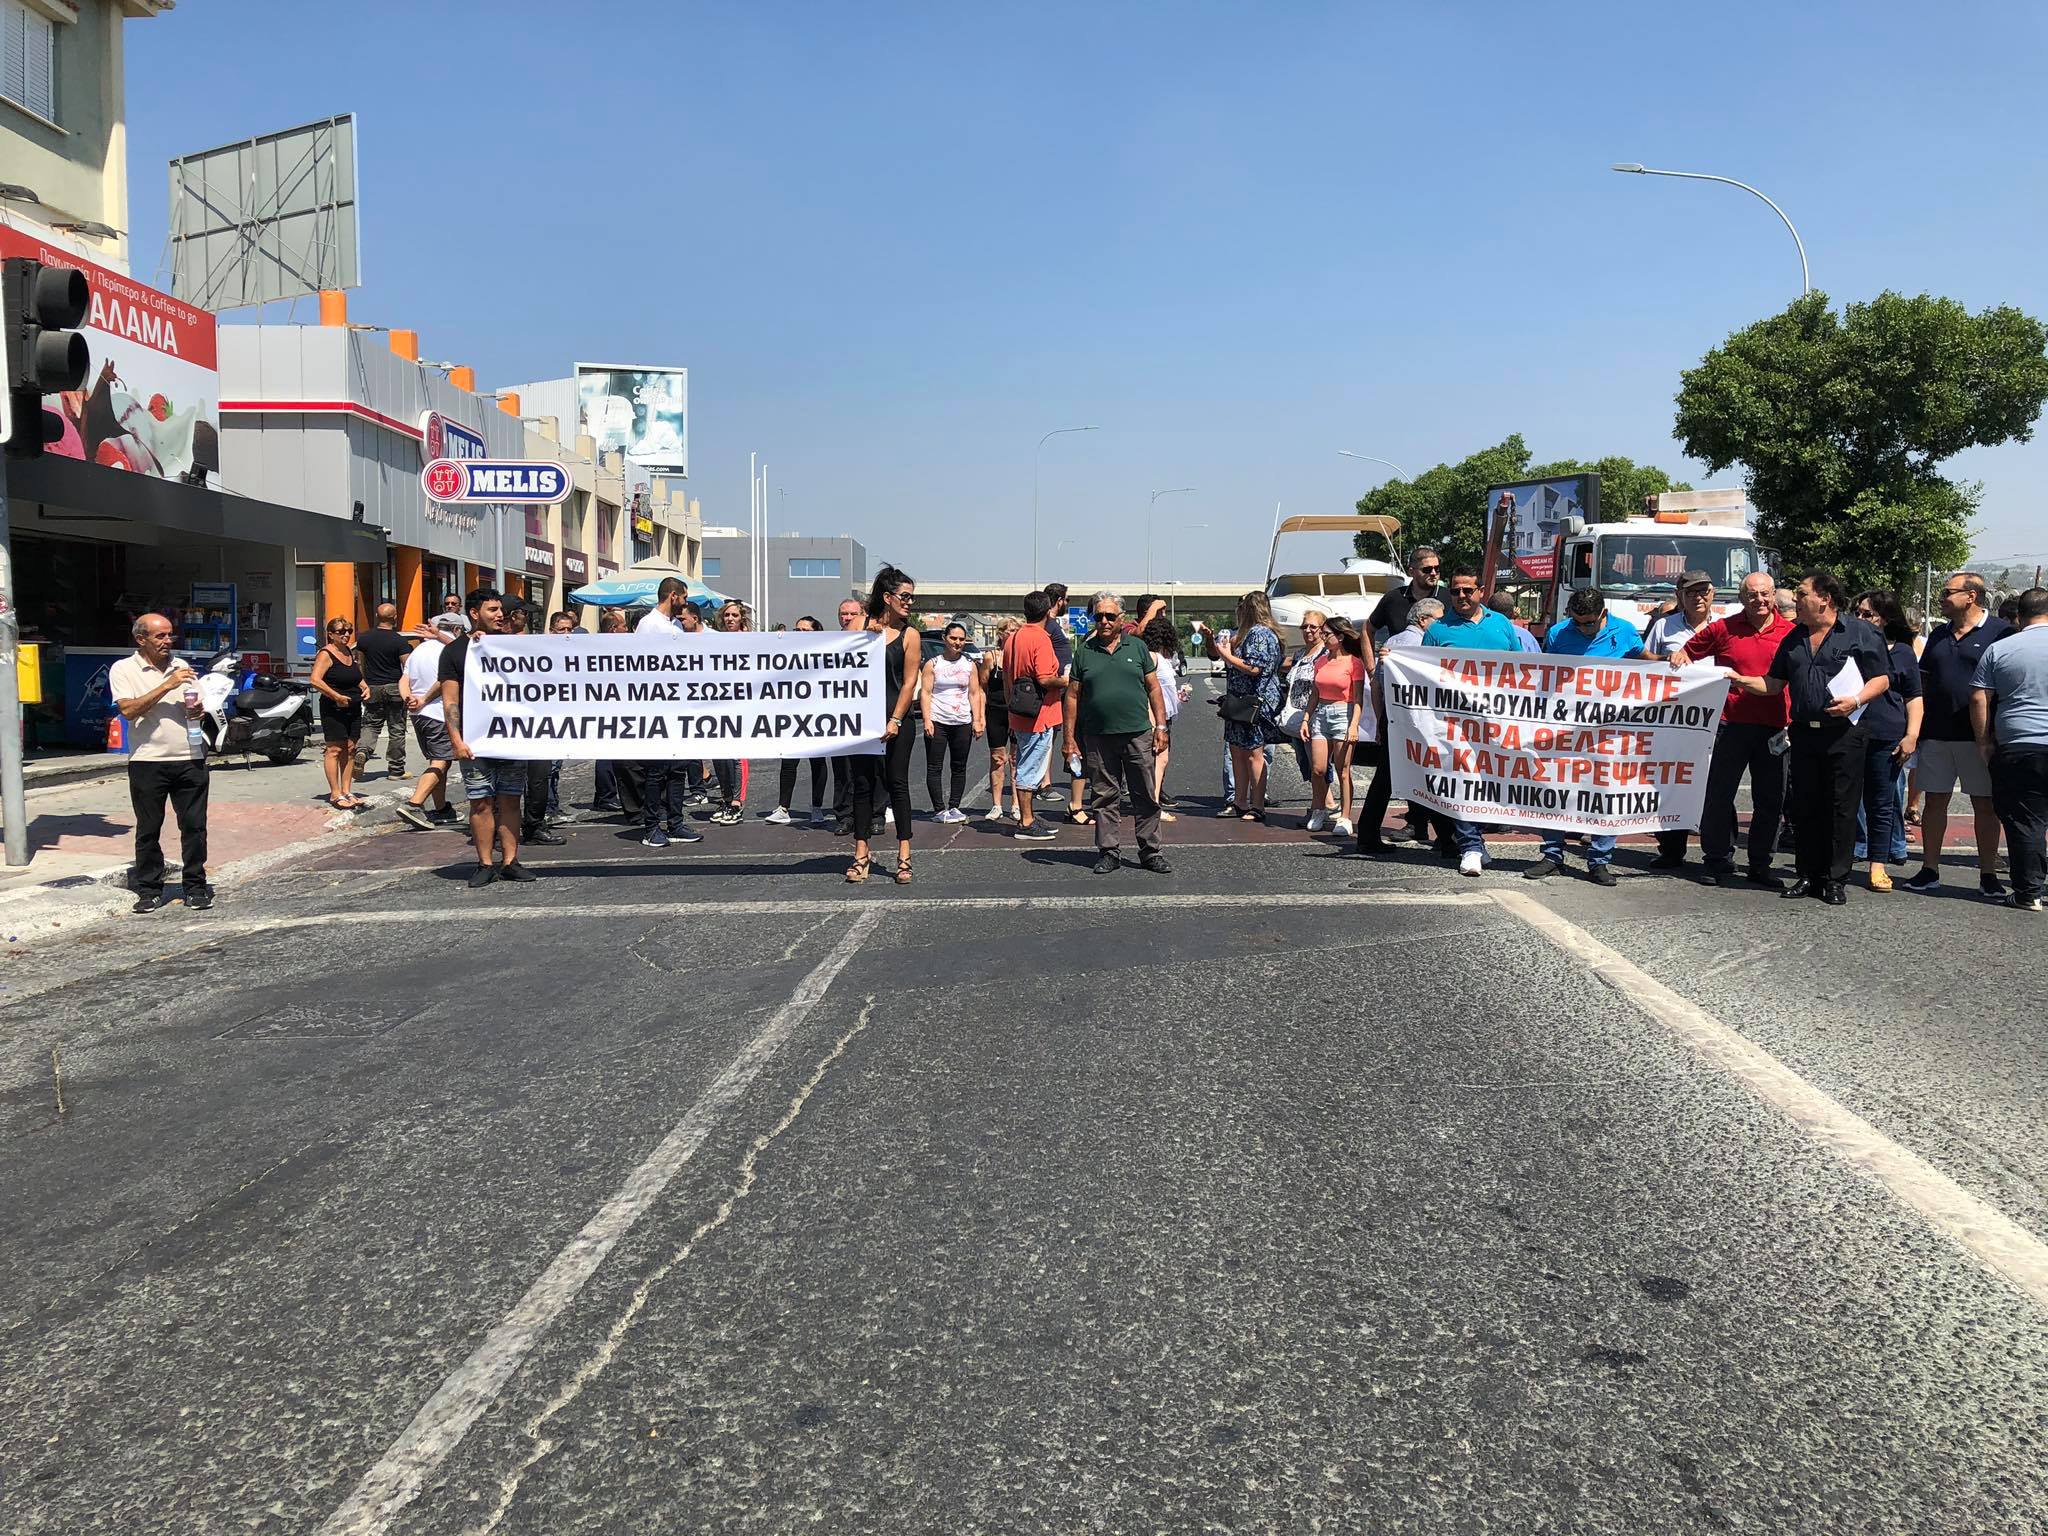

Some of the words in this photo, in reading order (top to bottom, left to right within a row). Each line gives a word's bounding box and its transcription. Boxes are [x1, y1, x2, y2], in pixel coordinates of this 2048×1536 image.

[98, 271, 139, 302] Περίπτερο
[141, 291, 149, 306] &
[150, 294, 177, 316] Coffee
[178, 309, 187, 320] to
[187, 313, 198, 327] go
[472, 469, 558, 493] MELIS
[616, 582, 658, 592] ΑΓΡΟ
[480, 655, 553, 673] ΜΟΝΟ
[565, 655, 580, 672] Η
[587, 654, 704, 672] ΕΠΕΜΒΑΣΗ
[710, 654, 750, 671] ΤΗΣ
[757, 651, 869, 670] ΠΟΛΙΤΕΙΑΣ
[1440, 658, 1682, 702] ΚΑΤΑΣΤΡΕΨΑΤΕ
[481, 682, 577, 702] ΜΠΟΡΕΙ
[585, 682, 621, 702] ΝΑ
[628, 682, 680, 702] ΜΑΣ
[687, 681, 752, 701] ΣΩΣΕΙ
[760, 680, 811, 700] ΑΠΟ
[818, 679, 868, 699] ΤΗΝ
[1392, 683, 1428, 706] ΤΗΝ
[1435, 687, 1547, 719] ΜΙΣΙΑΟΥΛΗ
[1553, 699, 1569, 721] &
[1574, 701, 1715, 728] ΚΑΒΑΖΟΓΛΟΥ
[216, 708, 227, 726] SYM
[487, 715, 669, 739] ΑΝΑΛΓΗΣΙΑ
[678, 714, 742, 739] ΤΩΝ
[751, 712, 862, 738] ΑΡΧΩΝ
[1444, 715, 1521, 750] ΤΩΡΑ
[1533, 728, 1654, 756] ΘΕΛΕΤΕ
[1406, 738, 1442, 769] ΝΑ
[1453, 748, 1695, 787] ΚΑΤΑΣΤΡΕΨΕΤΕ
[1413, 788, 1440, 806] ΟΜΑΔΑ
[1440, 802, 1517, 817] ΠΡΩΤΟΒΟΥΛΙΑΣ
[1519, 809, 1573, 823] ΜΙΣΙΑΟΥΛΗ
[1575, 816, 1583, 824] &
[1425, 774, 1457, 799] ΚΑΙ
[1463, 779, 1501, 803] ΤΗΝ
[1508, 784, 1570, 810] ΝΙΚΟΥ
[1577, 789, 1660, 815] ΠΑΤΤΙΧΗ
